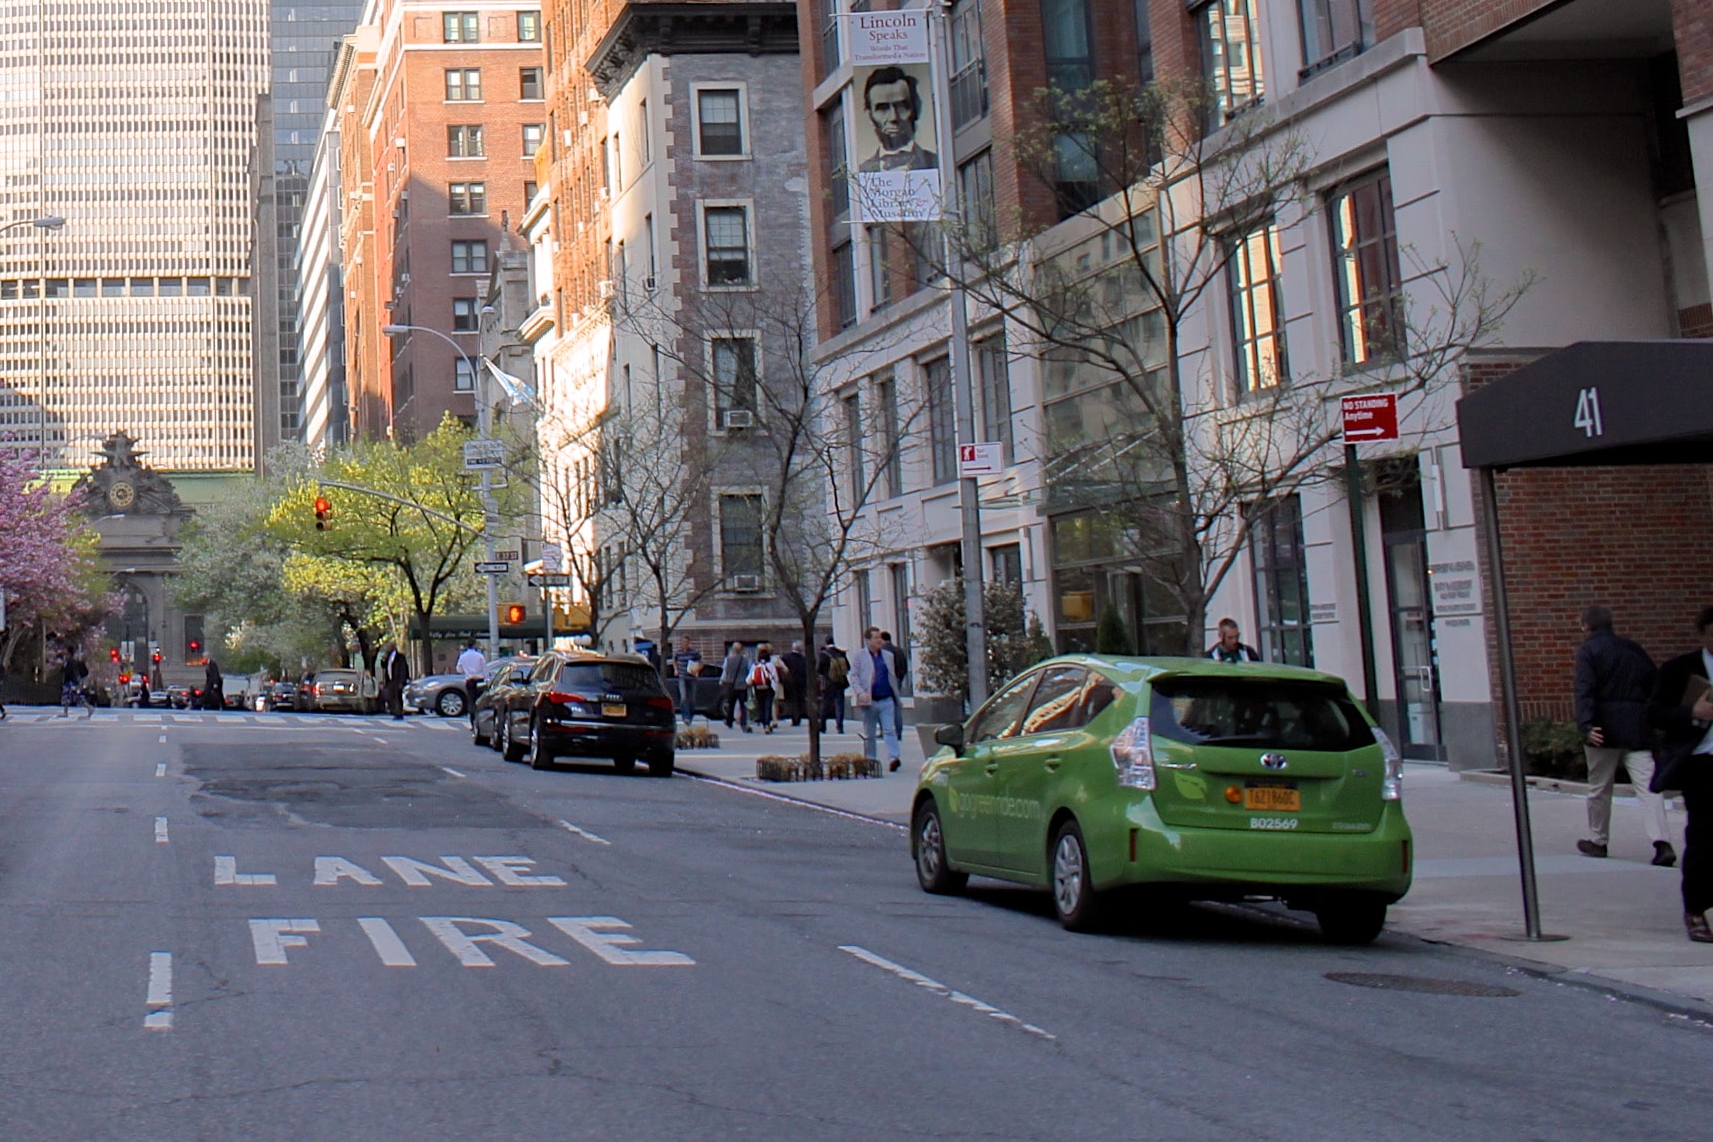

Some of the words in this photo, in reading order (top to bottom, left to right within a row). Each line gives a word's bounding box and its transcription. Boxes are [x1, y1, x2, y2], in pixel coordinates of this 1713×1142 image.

[860, 14, 916, 29] Lincoln
[869, 29, 908, 43] Speaks
[870, 177, 892, 187] The
[1343, 401, 1354, 410] NO
[1354, 398, 1389, 409] STANDING
[1345, 411, 1374, 422] Anytime
[1574, 386, 1603, 438] 41
[1250, 817, 1298, 829] B02569
[214, 856, 567, 886] LANE
[248, 916, 697, 967] FIRE
